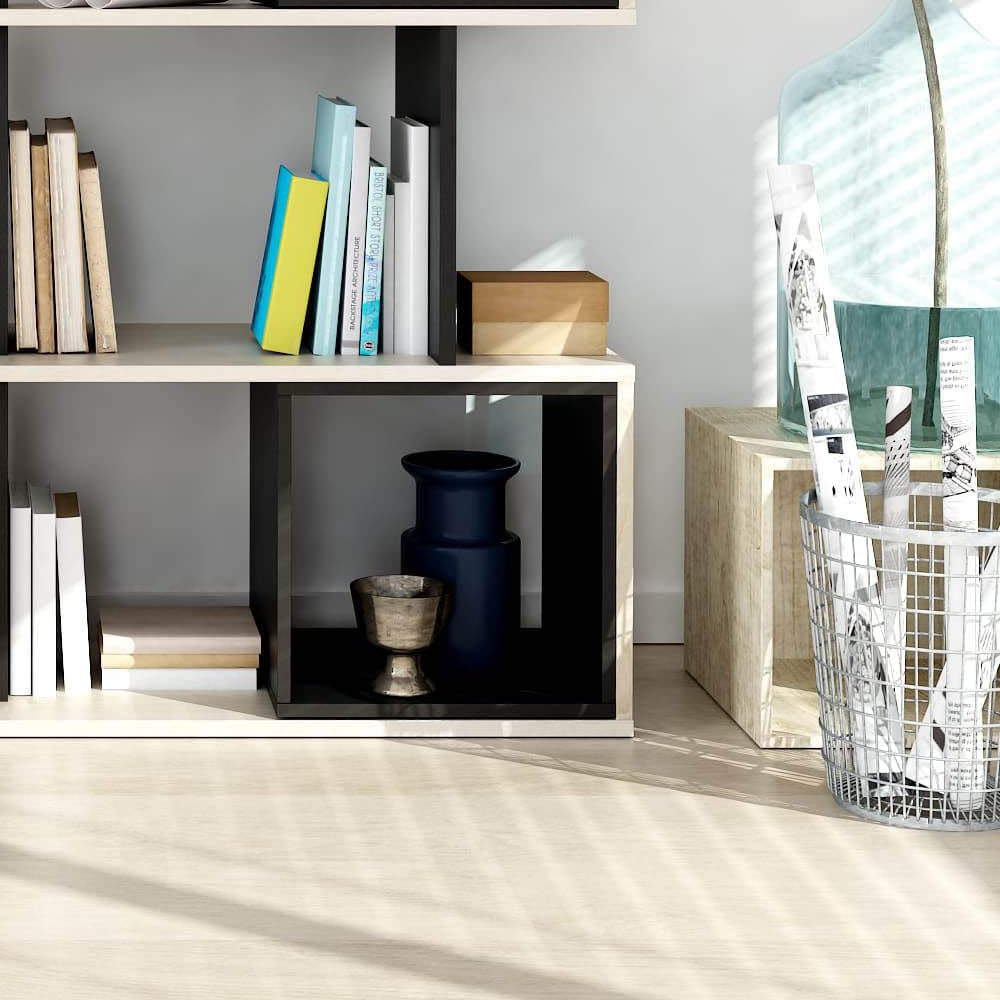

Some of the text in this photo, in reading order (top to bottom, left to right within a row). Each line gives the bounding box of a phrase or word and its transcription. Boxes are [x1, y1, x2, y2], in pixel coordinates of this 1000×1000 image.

[373, 171, 385, 203] BRISTOL
[371, 205, 382, 232] SHORT
[349, 236, 361, 331] BACKSTAGE ARCHITECTURE
